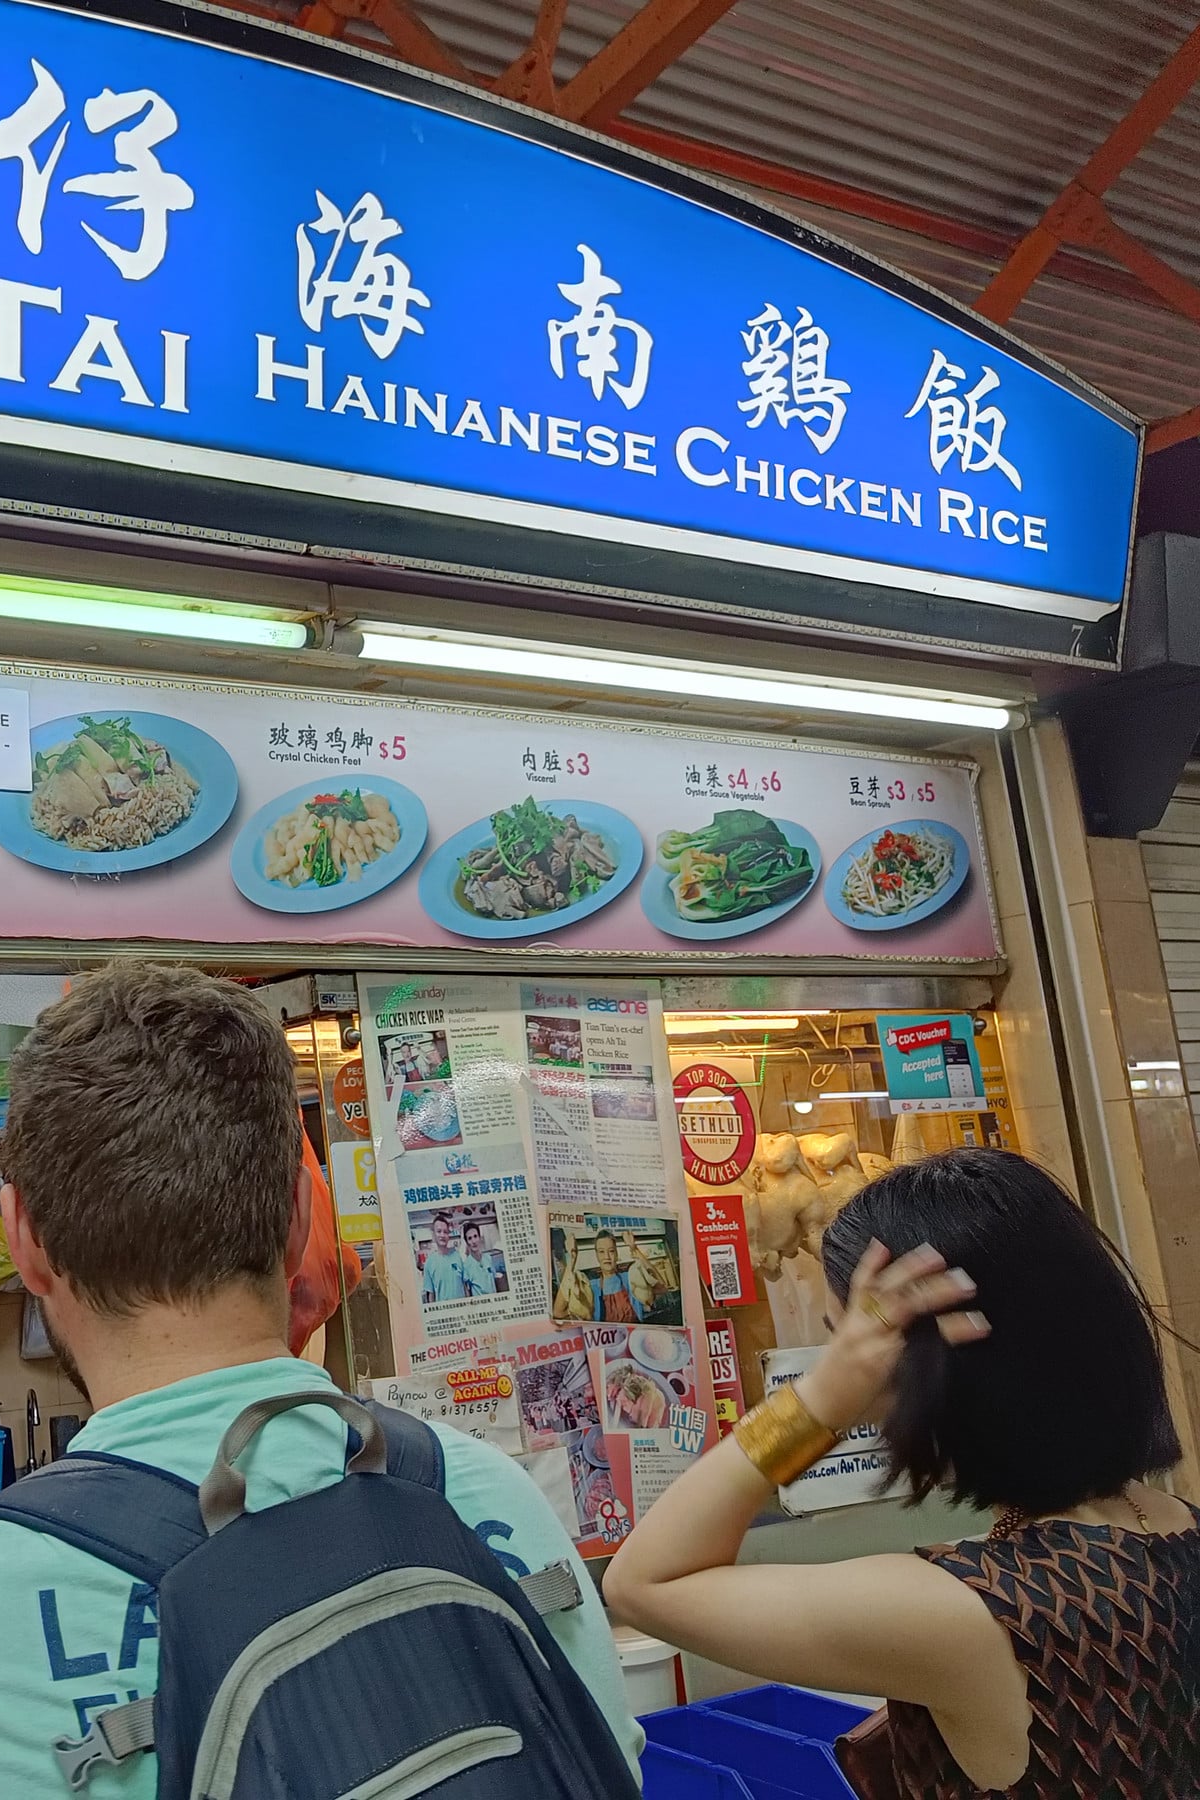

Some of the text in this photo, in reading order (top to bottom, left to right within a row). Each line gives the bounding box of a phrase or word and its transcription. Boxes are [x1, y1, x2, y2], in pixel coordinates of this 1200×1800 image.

[255, 333, 657, 476] HAINANESE
[674, 426, 922, 527] CHICKEN
[938, 488, 1048, 552] RICE
[269, 722, 407, 761] 玻璃鸡脚 $5
[268, 750, 361, 766] Crystal Chicken Feet
[522, 747, 590, 776] 内脏 $3
[685, 765, 723, 789] 油菜
[709, 789, 729, 800] Sauce
[730, 791, 765, 802] Vegetable
[848, 776, 881, 800] 豆芽
[322, 995, 336, 1005] SK
[586, 997, 648, 1015] asiaone
[375, 1009, 445, 1029] CHICKEN RICE WAR
[898, 1027, 947, 1045] CDC Voucher
[587, 1049, 629, 1059] Chicken Rice
[347, 1067, 364, 1075] PEO
[902, 1056, 942, 1074] Accepted
[343, 1078, 363, 1087] LOV
[686, 1069, 727, 1088] TOP 300
[924, 1070, 945, 1083] here
[343, 1100, 367, 1121] yel
[680, 1115, 741, 1133] SETHLUI
[690, 1159, 740, 1182] HAWKER
[359, 1195, 378, 1207] 大众
[696, 1220, 739, 1232] Cashback
[411, 1351, 427, 1364] THE
[428, 1337, 478, 1359] CHICKEN
[516, 1335, 583, 1366] Means
[584, 1328, 617, 1349] War
[448, 1367, 497, 1386] CALL ME
[388, 1384, 427, 1406] Paynow
[454, 1385, 496, 1401] AGAIN!
